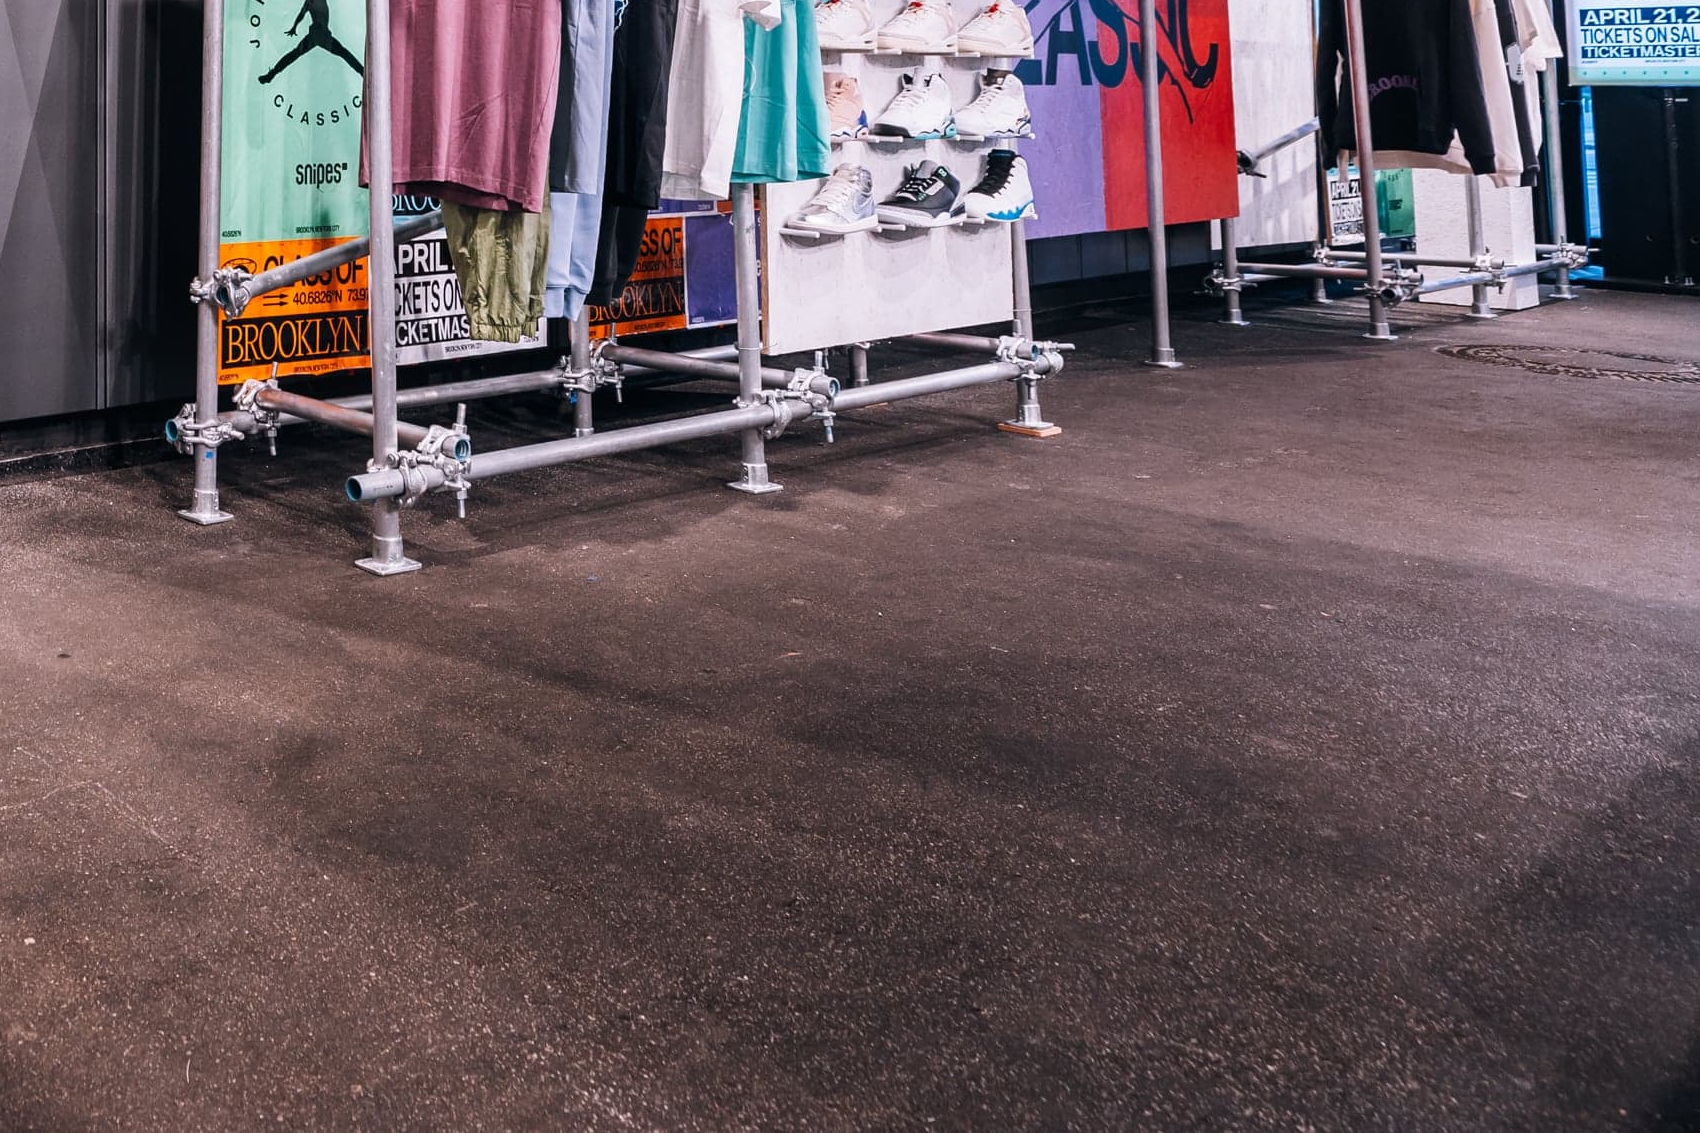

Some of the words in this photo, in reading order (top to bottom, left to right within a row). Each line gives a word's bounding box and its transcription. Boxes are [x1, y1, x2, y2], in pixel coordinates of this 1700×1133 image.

[1583, 9, 1650, 25] APRIL
[1653, 8, 1682, 25] 21,
[1580, 27, 1643, 44] TICKETS
[1646, 26, 1667, 44] ON
[274, 94, 362, 126] CLASSIC
[296, 163, 342, 188] snipes
[660, 227, 682, 255] OF
[226, 316, 364, 364] BROOKLYN
